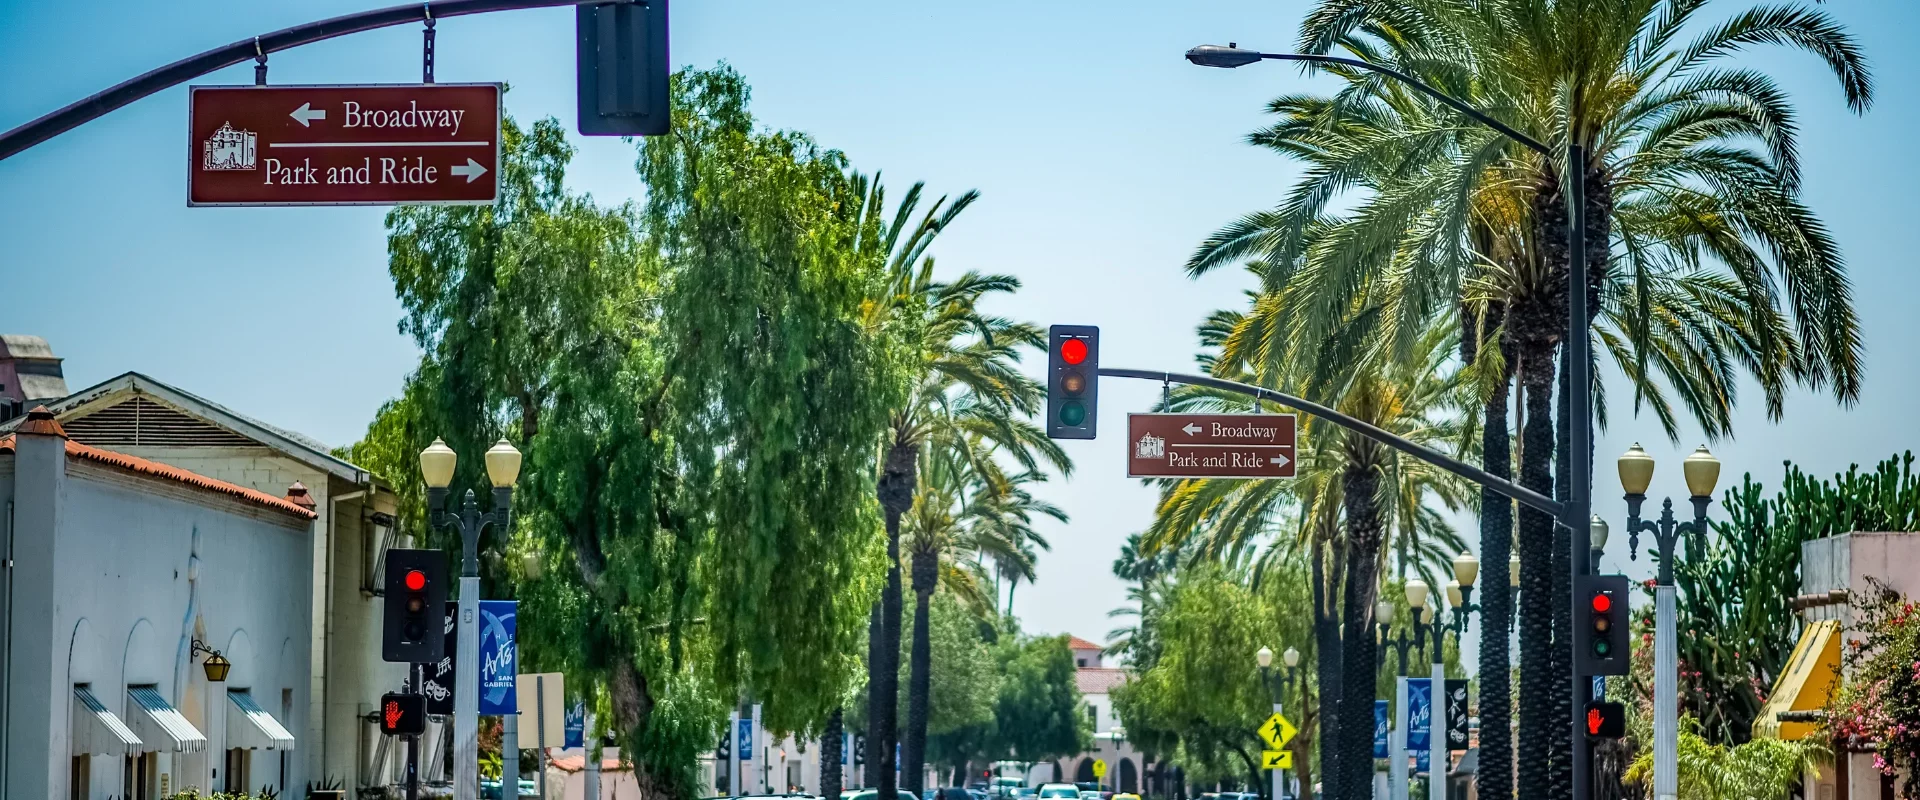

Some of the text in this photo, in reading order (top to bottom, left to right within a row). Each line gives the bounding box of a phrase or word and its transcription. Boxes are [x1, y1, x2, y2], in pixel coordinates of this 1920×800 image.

[342, 100, 465, 136] Broadway
[263, 156, 438, 185] Park and Ride
[1211, 422, 1278, 442] Broadway
[1168, 452, 1264, 468] Park and Ride
[482, 639, 514, 681] Arts
[565, 701, 584, 727] Arts
[1410, 702, 1430, 729] Arts
